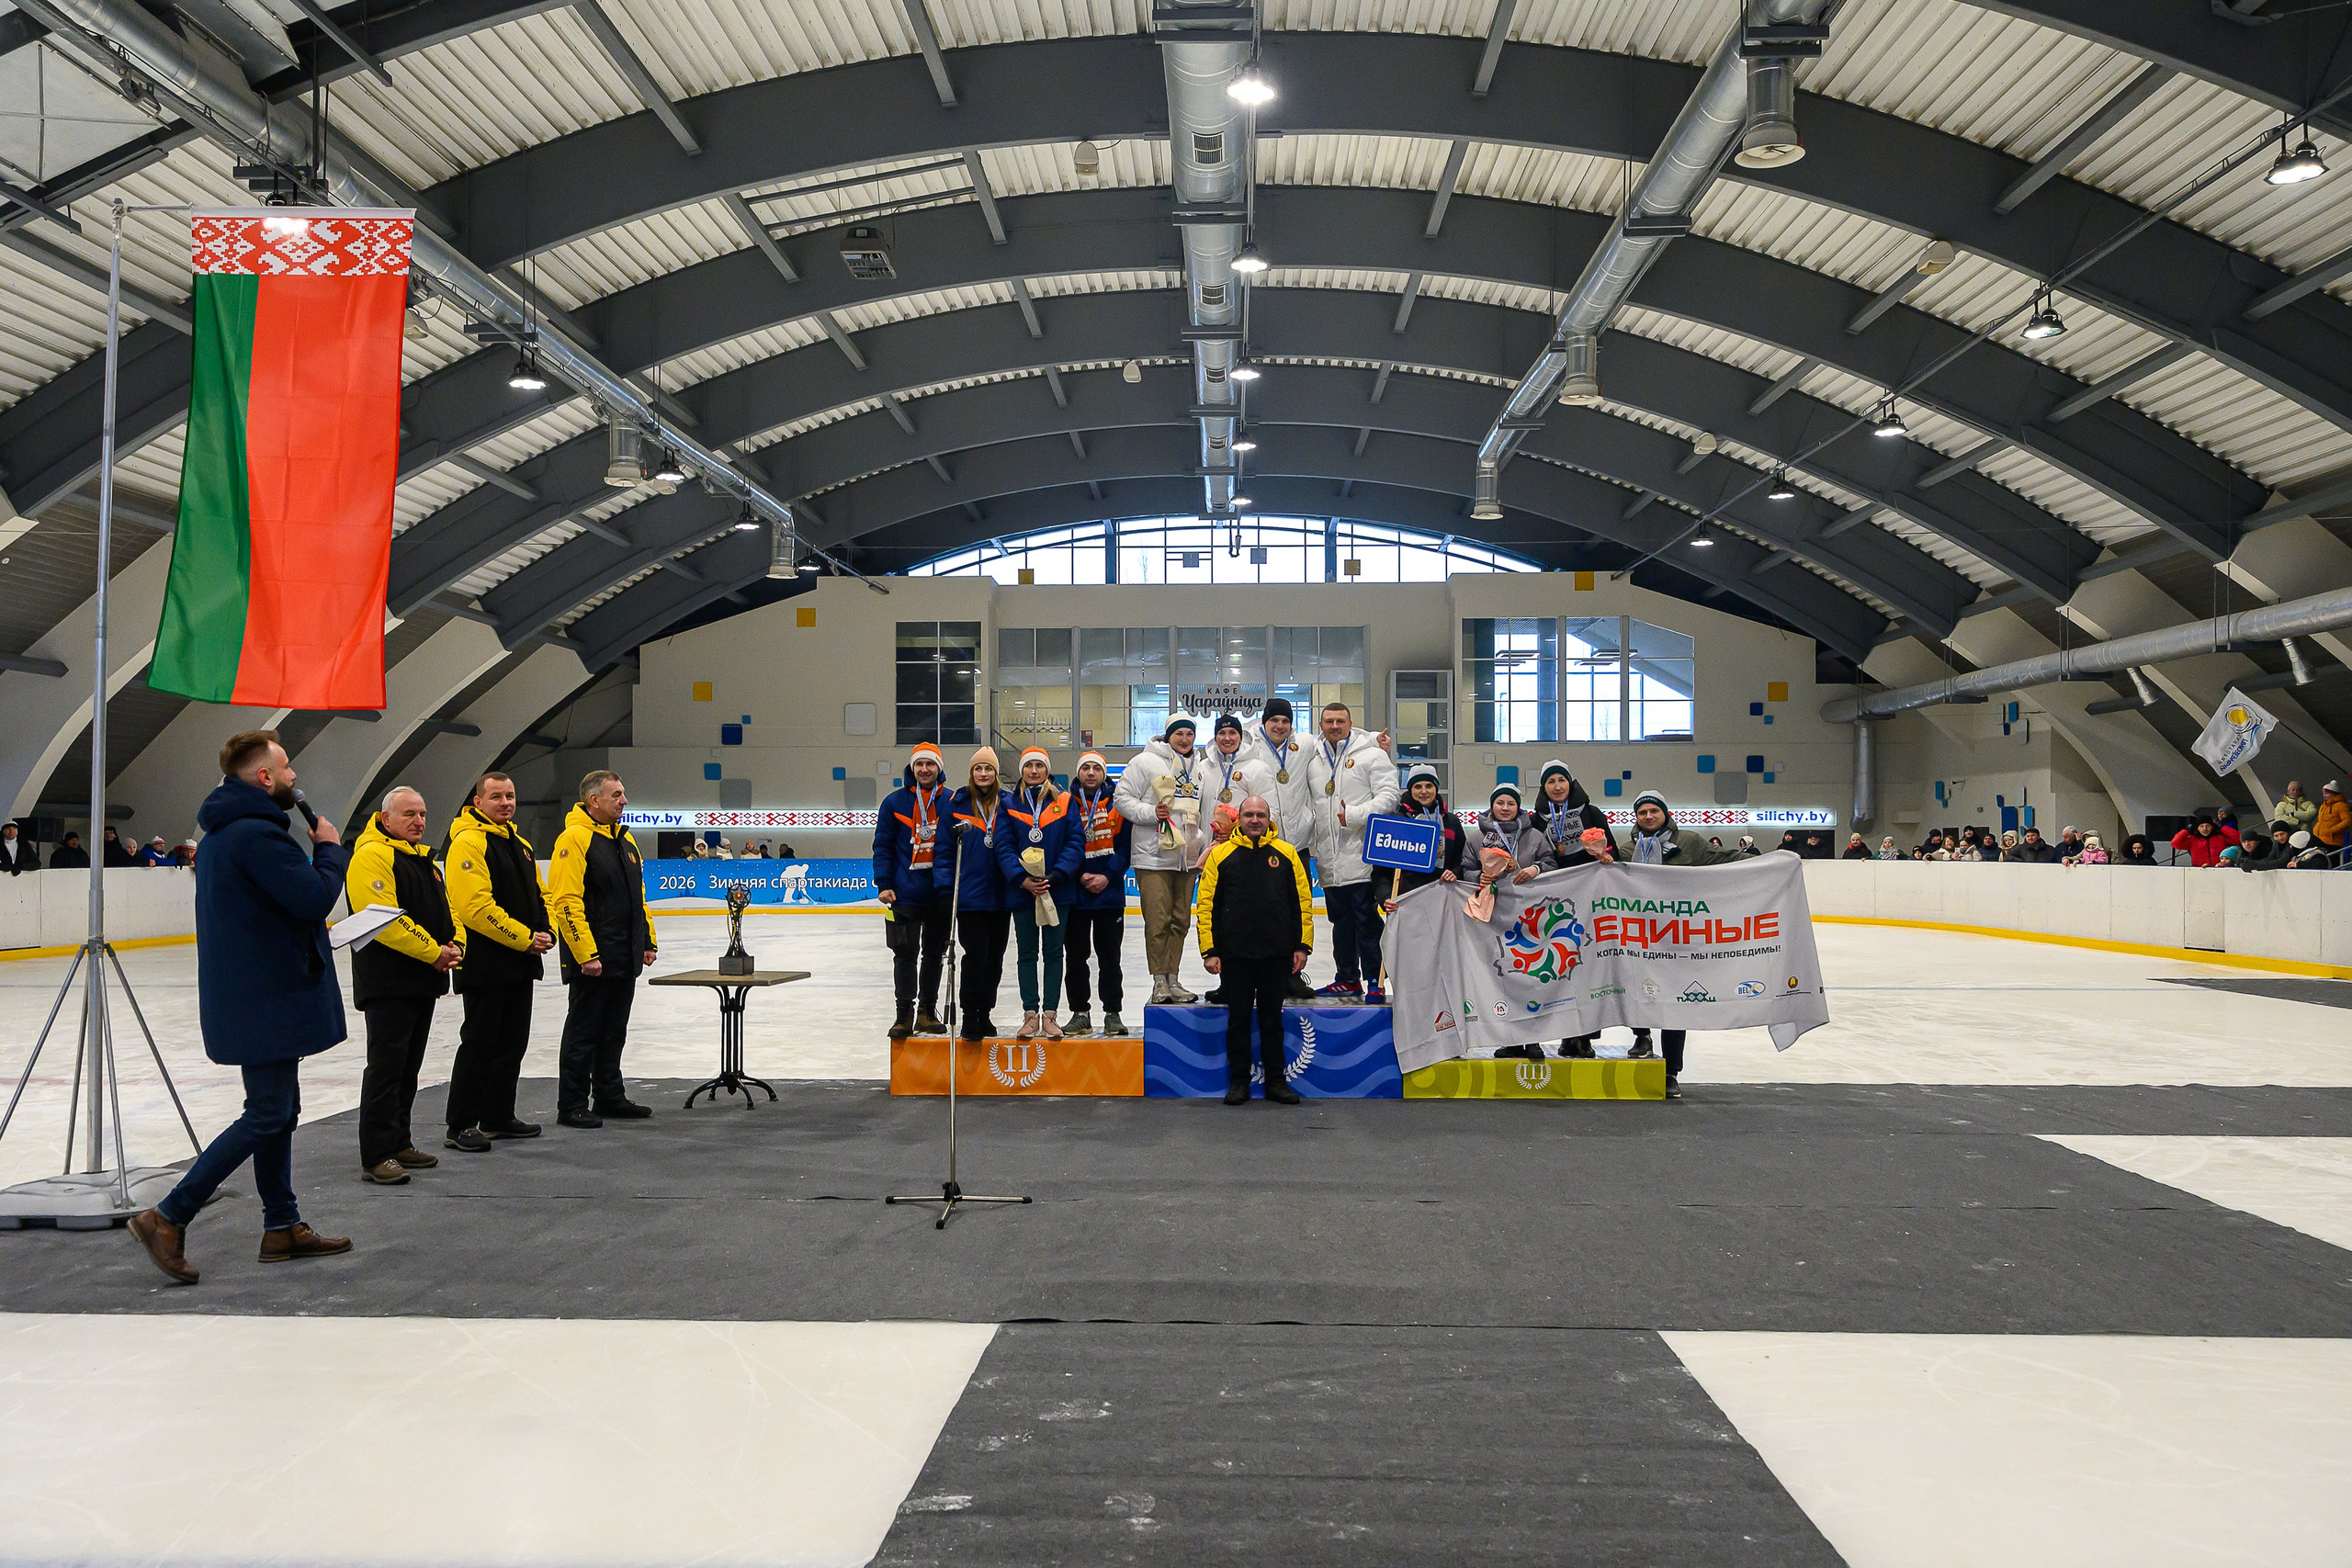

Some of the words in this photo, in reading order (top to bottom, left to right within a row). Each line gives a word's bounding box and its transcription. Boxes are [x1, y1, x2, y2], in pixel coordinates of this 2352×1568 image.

[1182, 694, 1262, 715] Чараўніца
[1756, 810, 1828, 823] silichy.by
[1550, 820, 1580, 835] ЕНЫЕ
[1374, 832, 1427, 853] Единые
[659, 875, 696, 890] 2026
[708, 874, 766, 889] Зимняя
[770, 877, 868, 891] спартакиада
[1591, 897, 1711, 917] КОМАНДА
[398, 917, 430, 944] BELARUS
[486, 914, 518, 941] BELARUS
[563, 906, 581, 942] BELARUS
[1593, 911, 1780, 949] ЕДИНЫЕ
[1596, 948, 1624, 958] КОГДА
[1626, 949, 1640, 958] МЫ
[1643, 951, 1677, 960] ЕДИНЫ
[1690, 952, 1709, 960] МЫ
[1711, 944, 1781, 959] НЕПОБЕДИМЫ!
[1003, 1045, 1031, 1073] II
[1521, 1064, 1545, 1079] III
